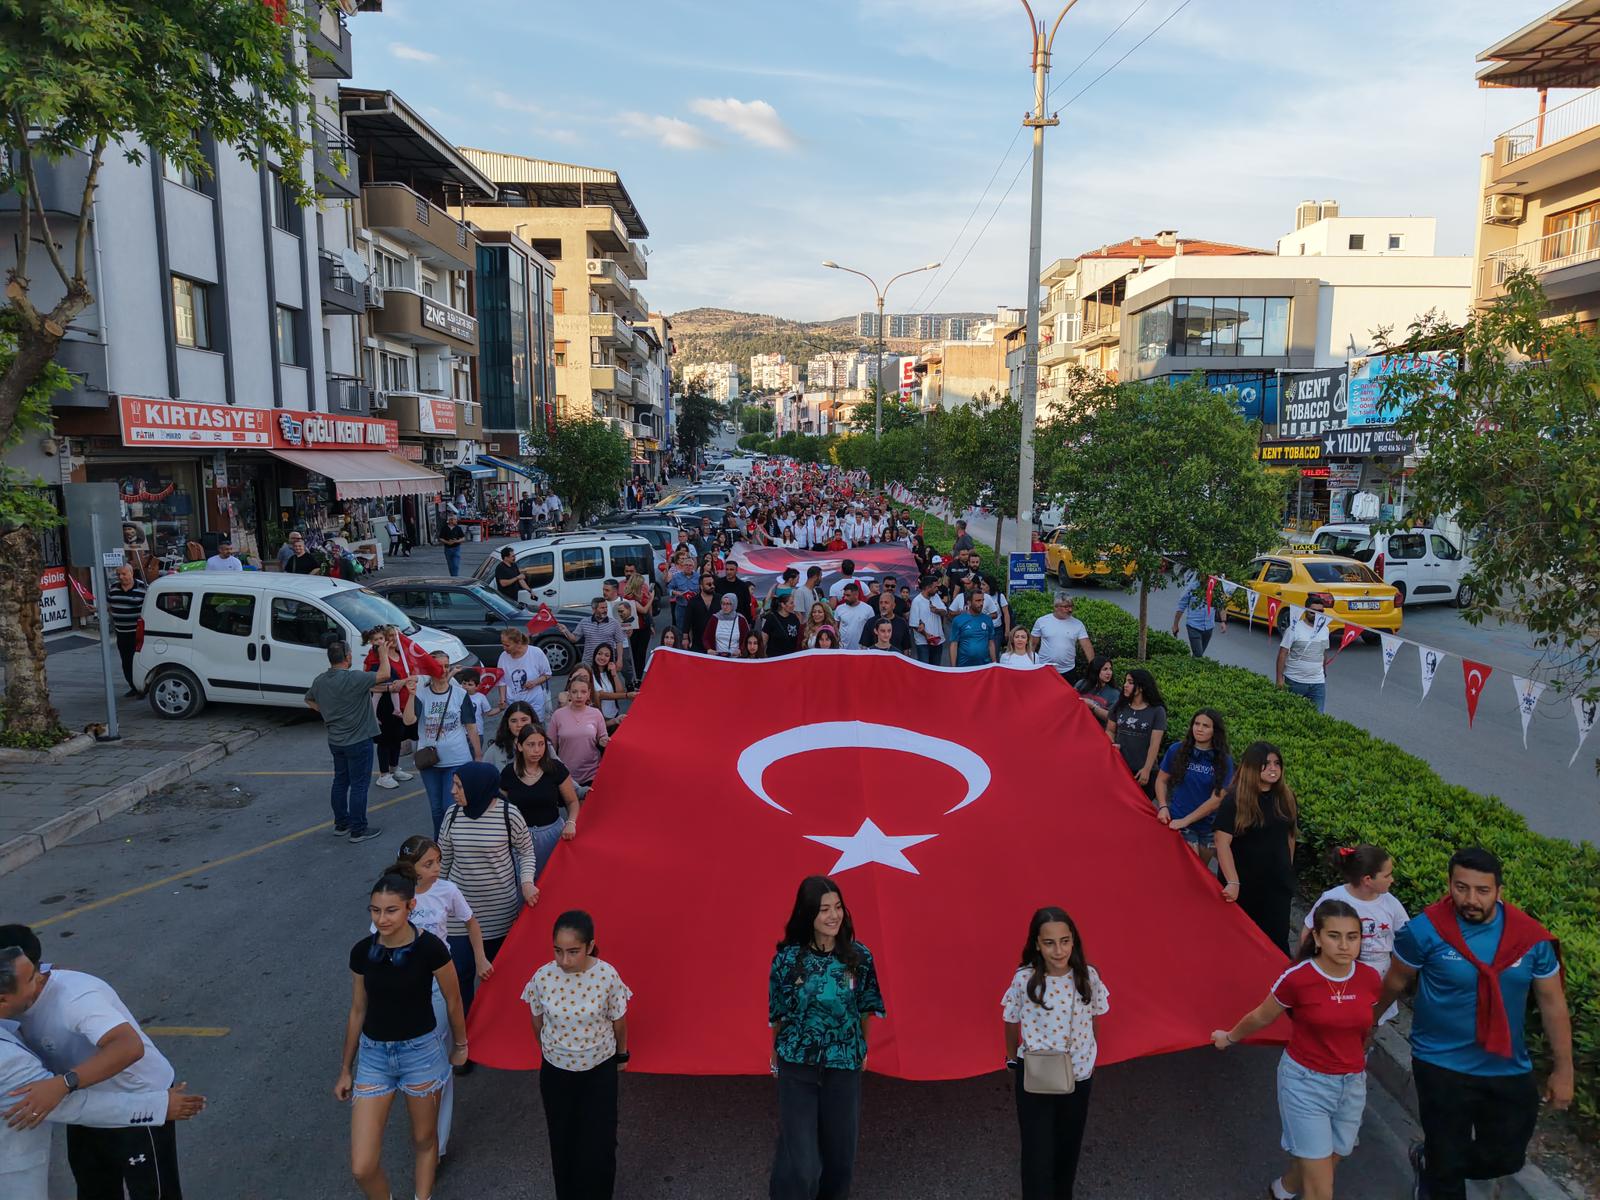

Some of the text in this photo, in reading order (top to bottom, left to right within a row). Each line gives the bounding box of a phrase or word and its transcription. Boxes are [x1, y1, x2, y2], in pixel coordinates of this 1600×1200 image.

[426, 304, 446, 327] ZNG
[1298, 376, 1331, 400] KENT
[1285, 401, 1331, 421] TOBACCO
[335, 420, 364, 443] KENT
[366, 422, 386, 445] AVM
[1337, 431, 1372, 453] YILDIZ
[1262, 445, 1321, 460] KENT TOBACCO
[38, 596, 56, 608] ARK
[41, 609, 67, 623] ILMAZ
